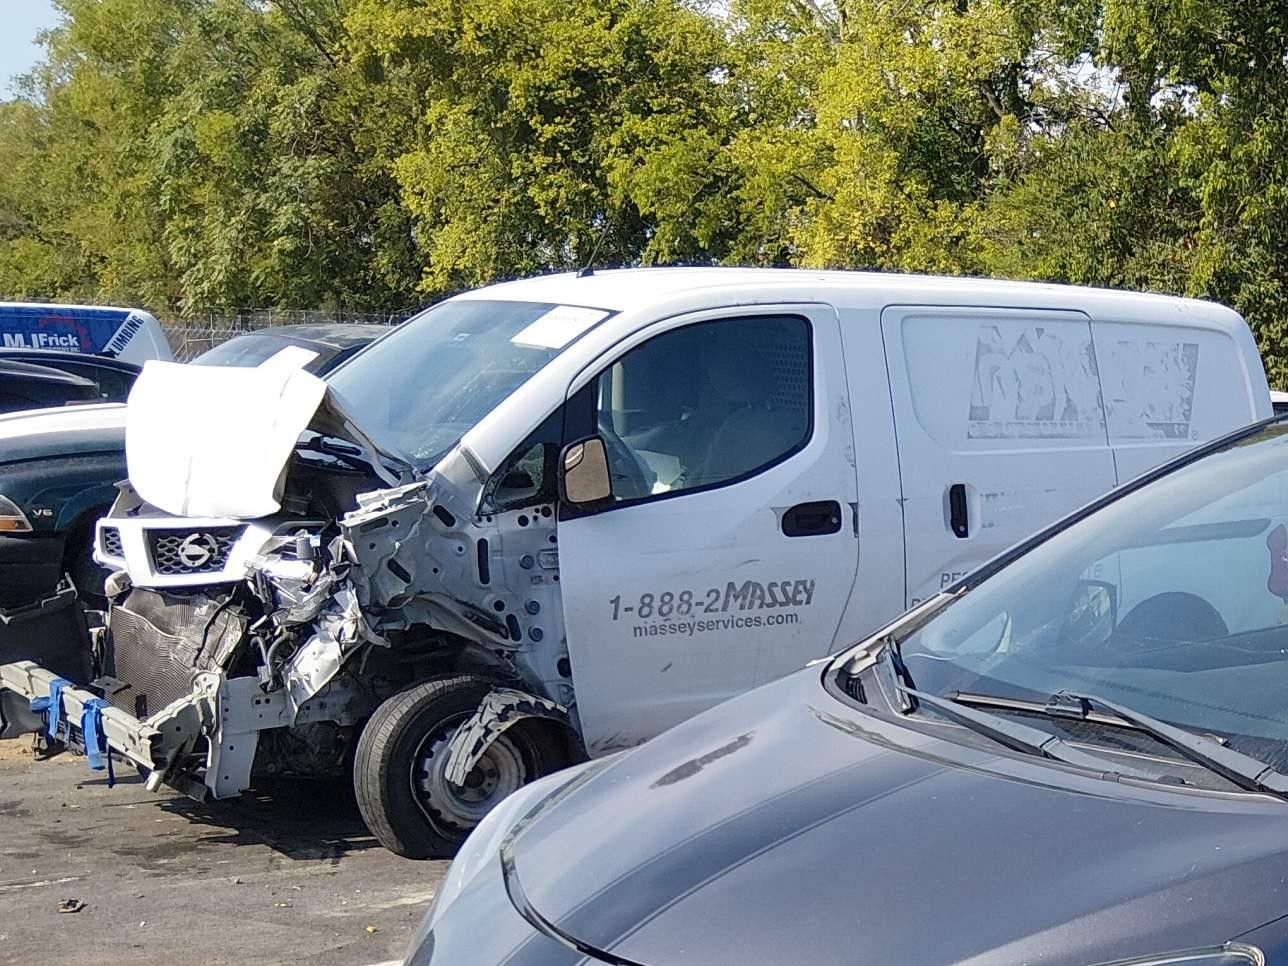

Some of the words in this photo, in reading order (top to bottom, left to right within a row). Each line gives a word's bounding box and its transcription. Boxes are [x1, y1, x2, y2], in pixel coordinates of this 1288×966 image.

[39, 333, 80, 346] Frick
[108, 314, 145, 356] LUMBING
[609, 579, 816, 621] 1-888-2MASSEY
[633, 612, 799, 637] masseyservices.com
